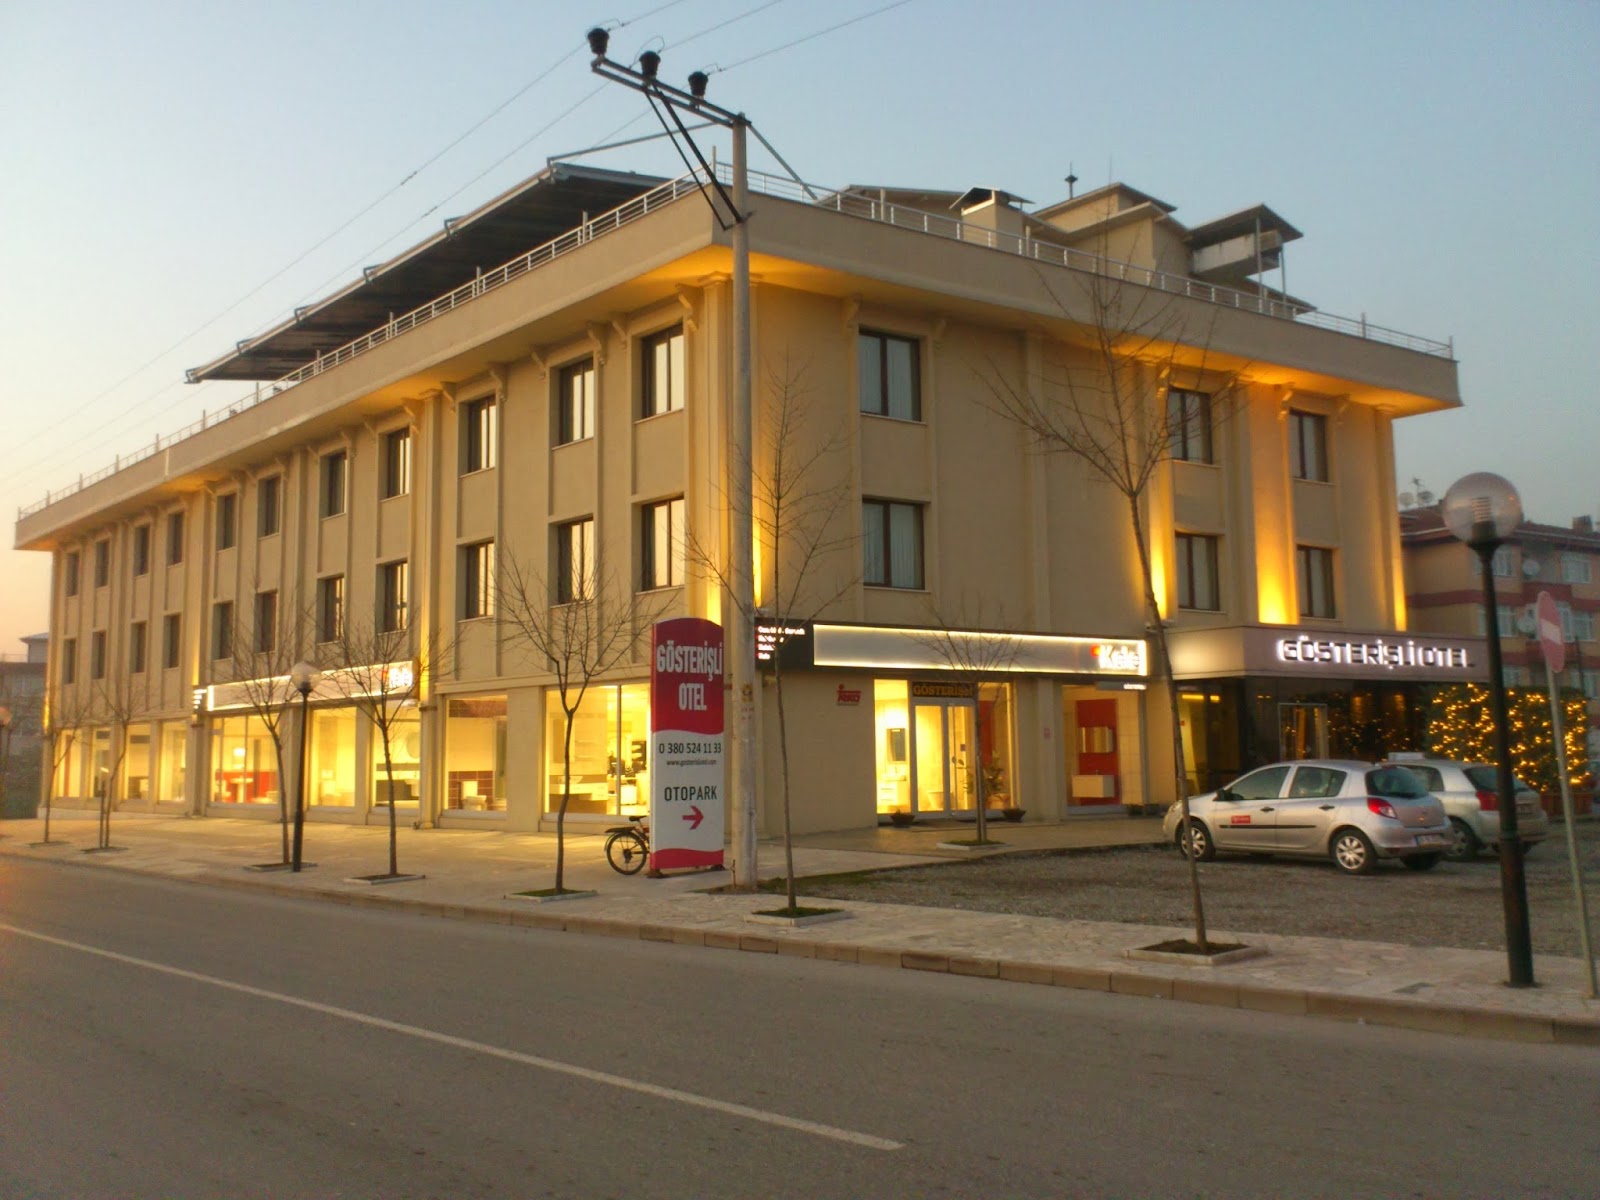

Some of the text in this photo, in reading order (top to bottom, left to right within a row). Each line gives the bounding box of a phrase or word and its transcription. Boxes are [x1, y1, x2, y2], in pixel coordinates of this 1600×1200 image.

[656, 640, 723, 681] GÖSTERİŞLİ
[1278, 635, 1476, 669] GÖSTERİŞLİ OTEL
[678, 682, 707, 711] OTEL
[658, 742, 722, 754] 0 380 524 11 33
[664, 785, 717, 801] OTOPARK
